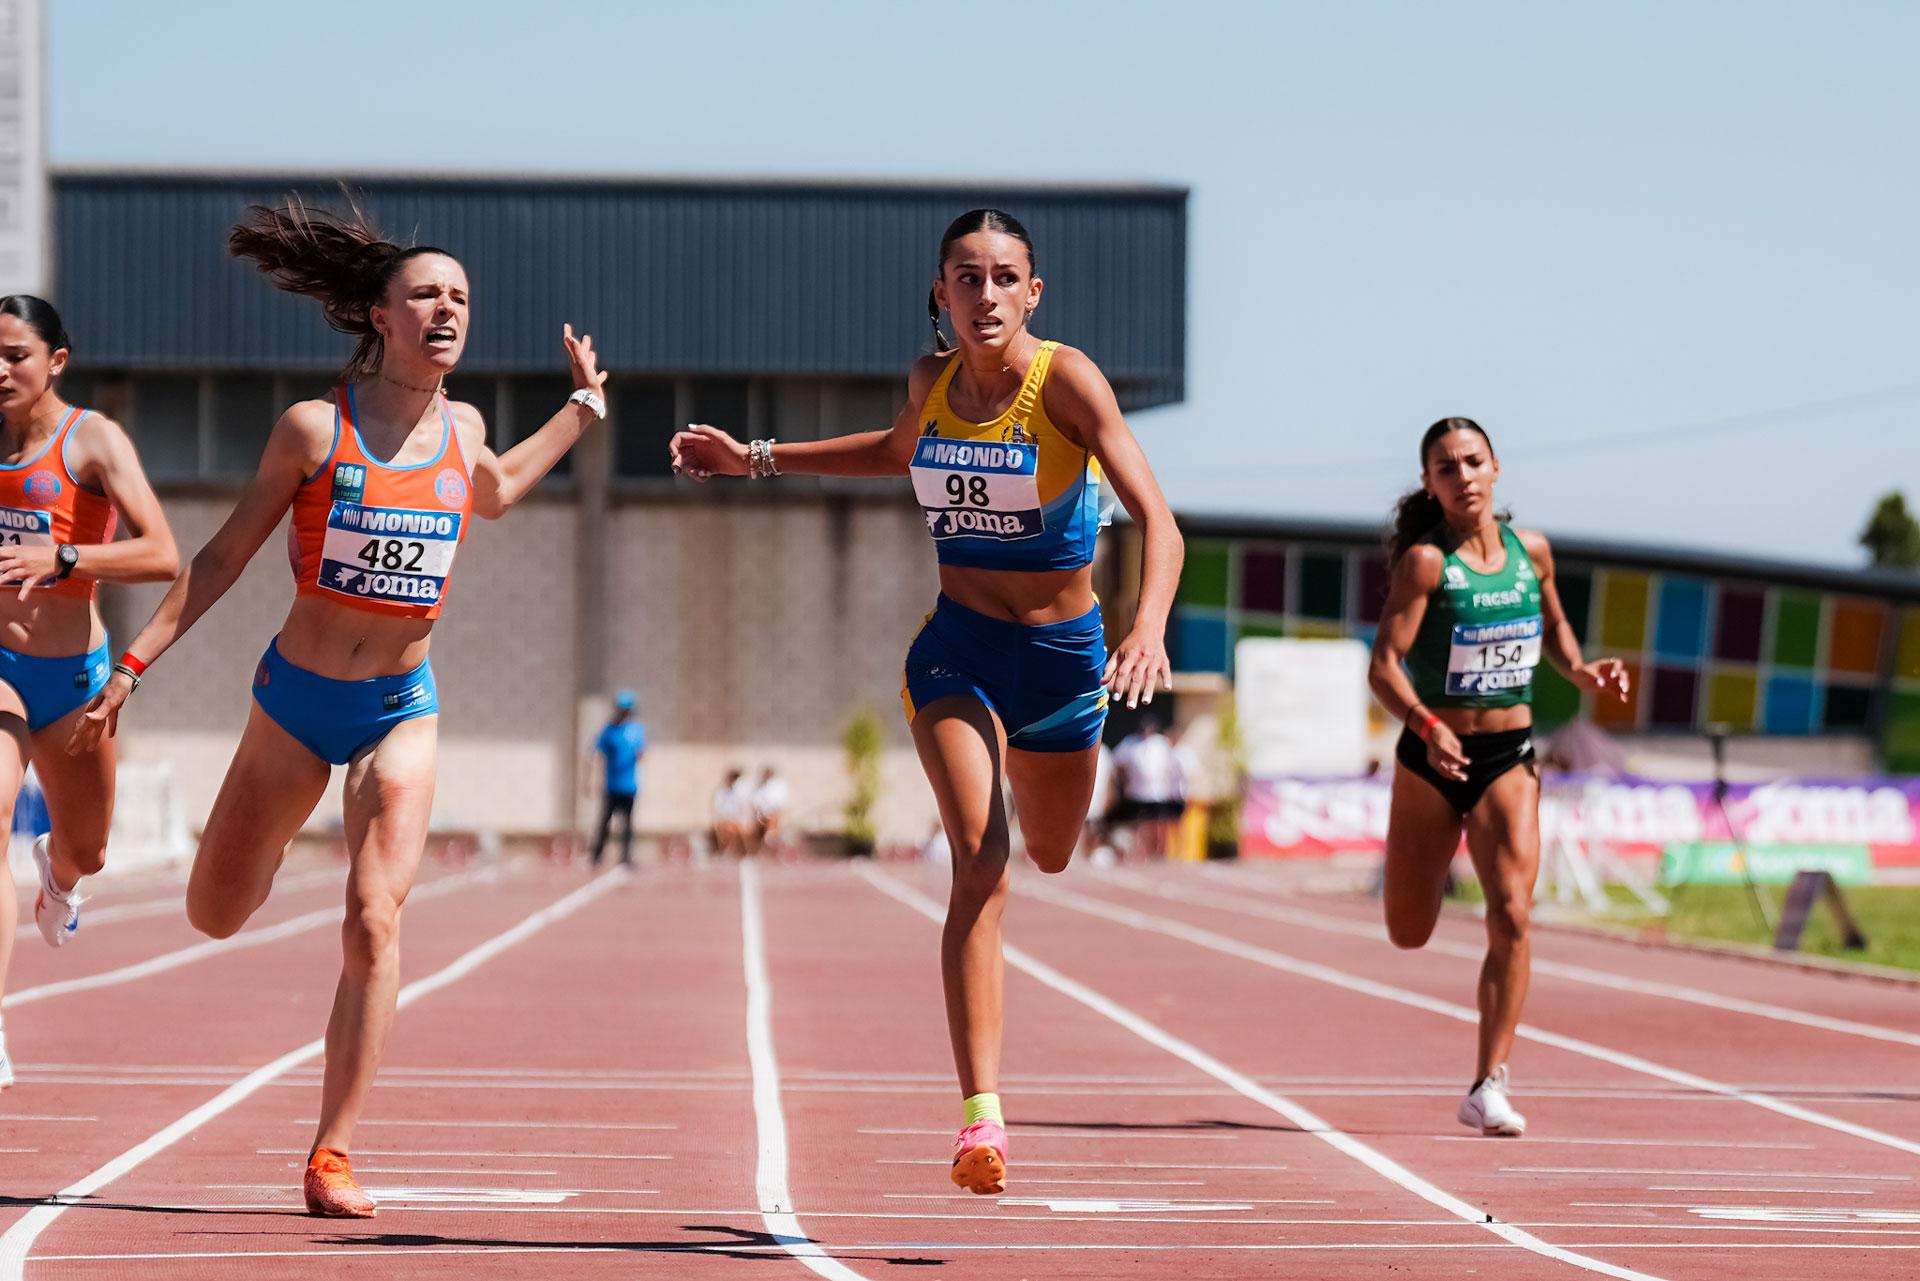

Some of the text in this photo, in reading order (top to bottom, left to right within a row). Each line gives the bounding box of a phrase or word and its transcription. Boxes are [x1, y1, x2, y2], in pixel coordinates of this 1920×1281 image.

[935, 443, 1023, 468] MONDO
[946, 474, 990, 507] 98
[360, 510, 452, 535] MONDO
[943, 510, 1025, 534] Joma
[357, 539, 425, 572] 482
[356, 572, 440, 599] Joma
[1477, 620, 1539, 642] MONDO
[1478, 645, 1522, 669] 154
